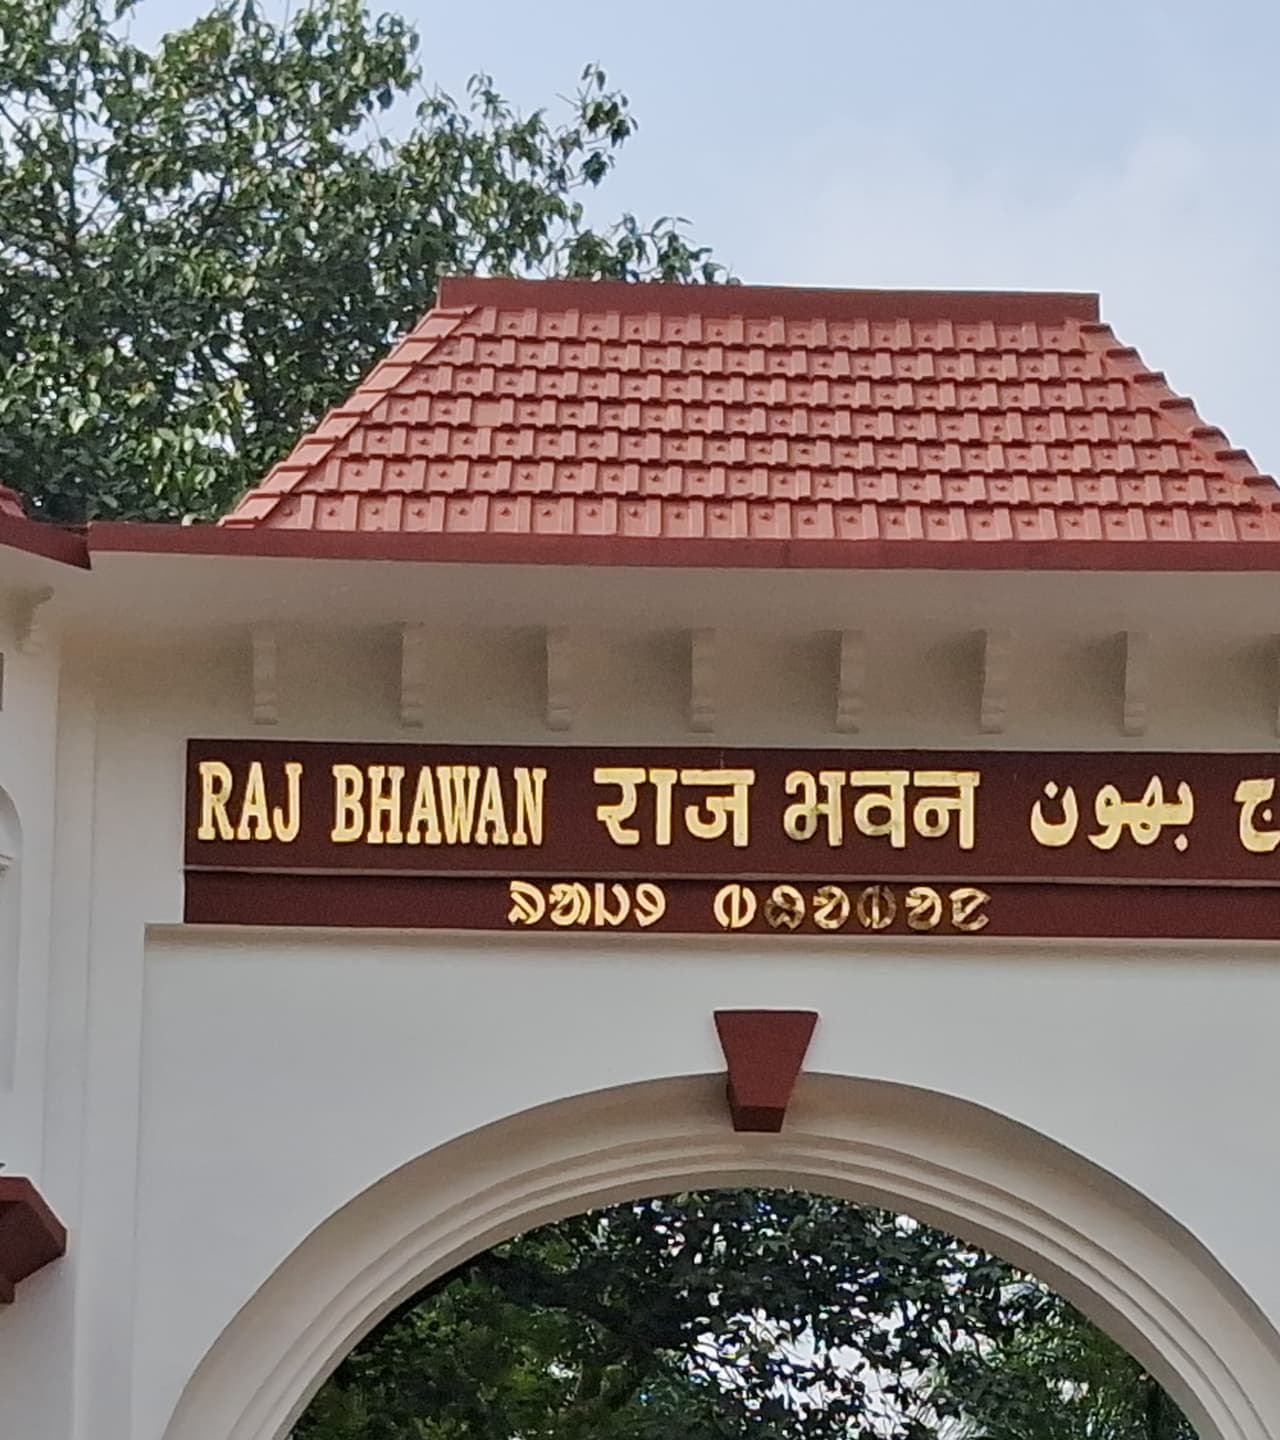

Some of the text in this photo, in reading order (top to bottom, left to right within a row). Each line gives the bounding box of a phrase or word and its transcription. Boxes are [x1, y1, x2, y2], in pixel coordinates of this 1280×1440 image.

[198, 761, 547, 846] RAJ BHAWAN
[593, 767, 980, 849] राज भवन
